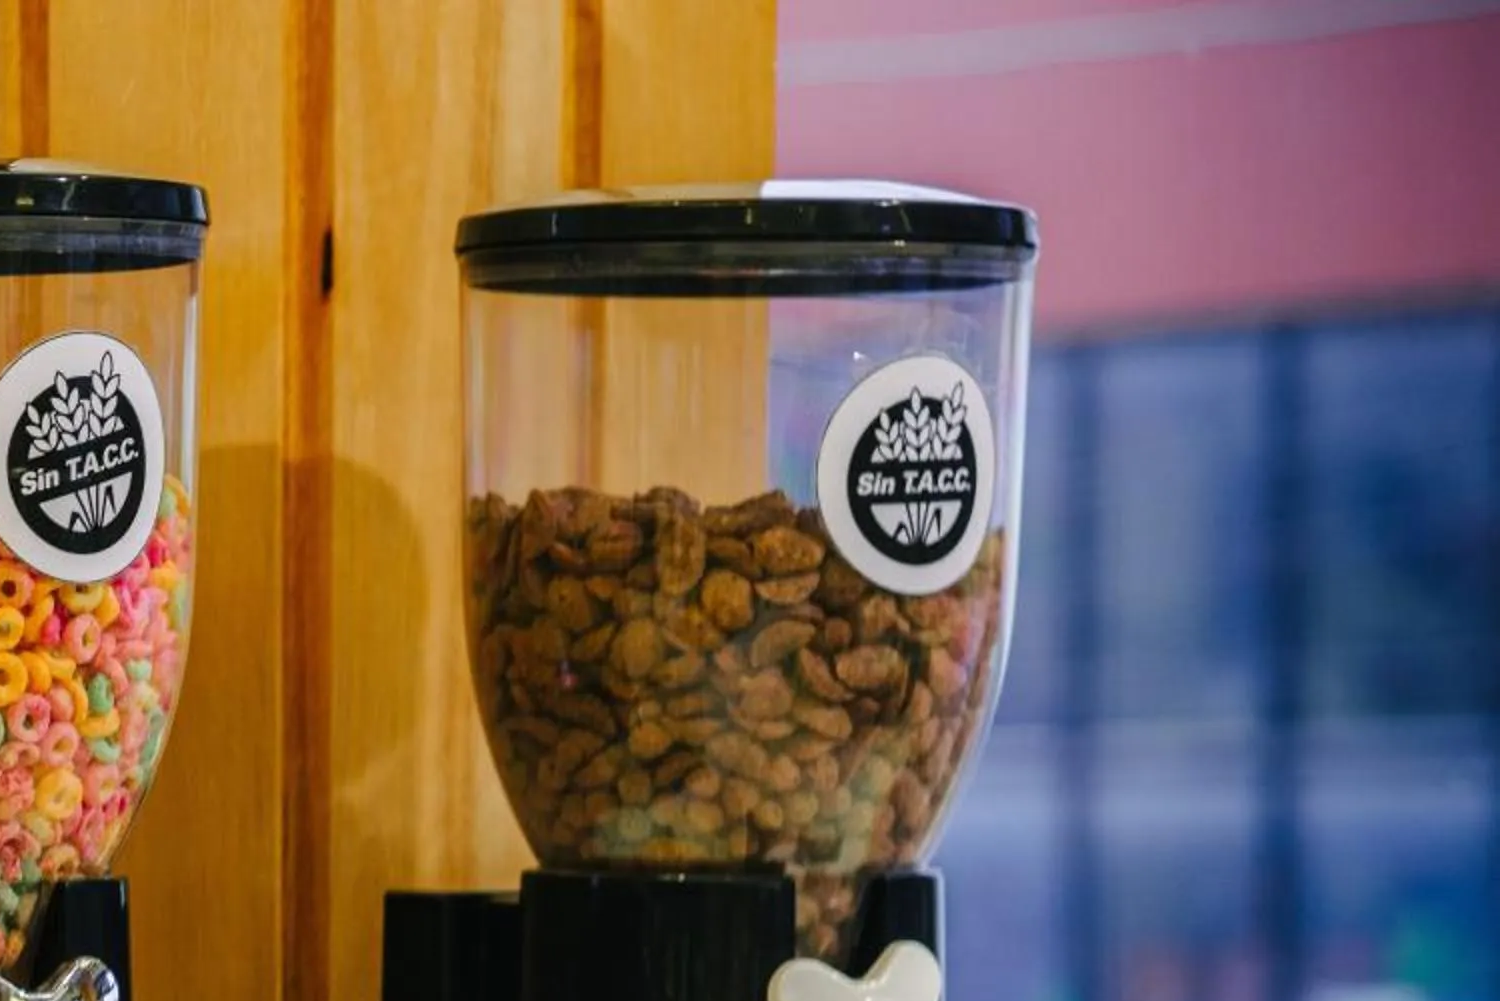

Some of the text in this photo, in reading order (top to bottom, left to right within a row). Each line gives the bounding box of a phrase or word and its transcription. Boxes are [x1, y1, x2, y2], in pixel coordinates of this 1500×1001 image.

[20, 437, 139, 496] Sin T.A.C.C.
[857, 466, 971, 497] Sin T.A.C.C.
